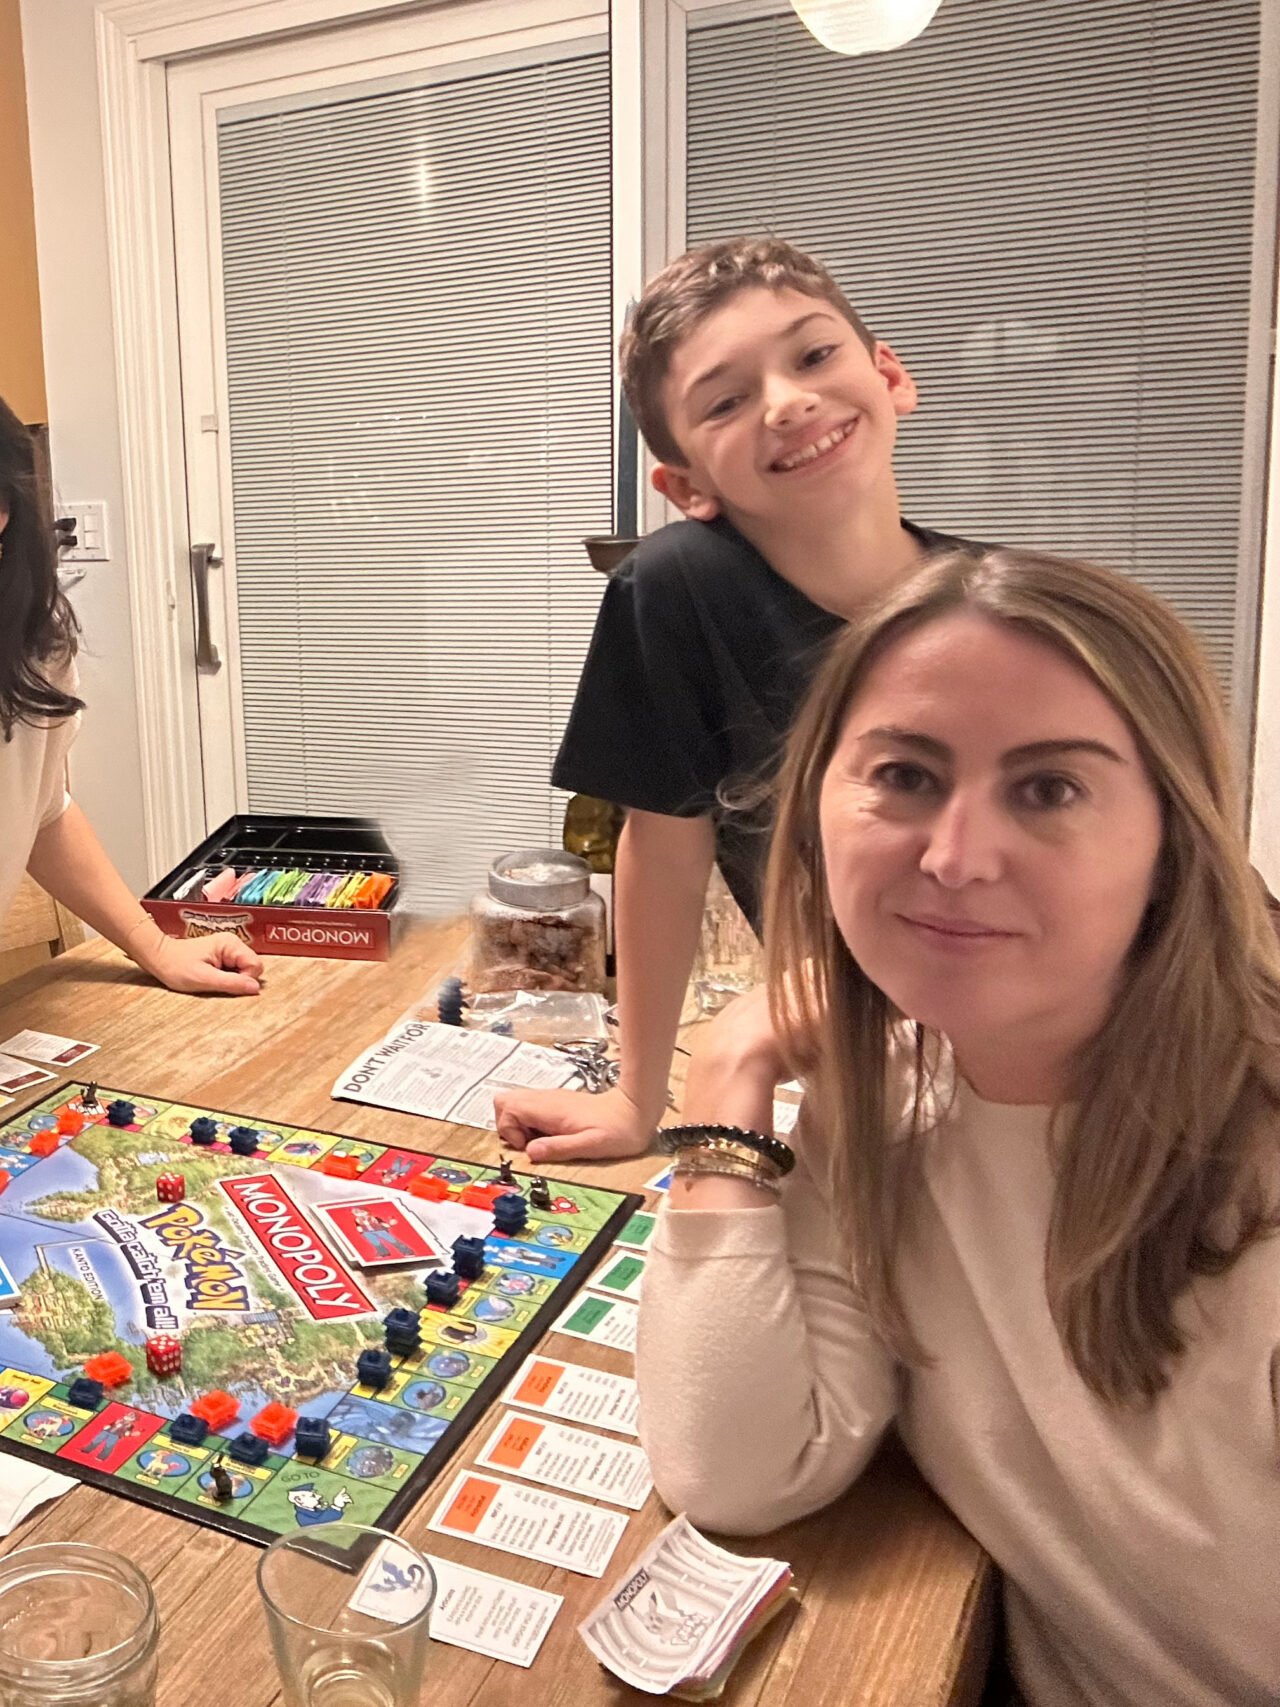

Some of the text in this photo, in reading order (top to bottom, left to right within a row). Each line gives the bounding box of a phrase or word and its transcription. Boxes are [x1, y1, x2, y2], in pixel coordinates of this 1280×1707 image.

[269, 926, 370, 945] MONOPOLY
[343, 1057, 386, 1093] DON'T
[233, 1182, 361, 1309] MONOPOLY
[72, 1248, 105, 1300] KANTO EDITION
[281, 1471, 320, 1482] GO TO
[616, 1570, 650, 1609] MONOPOLY
